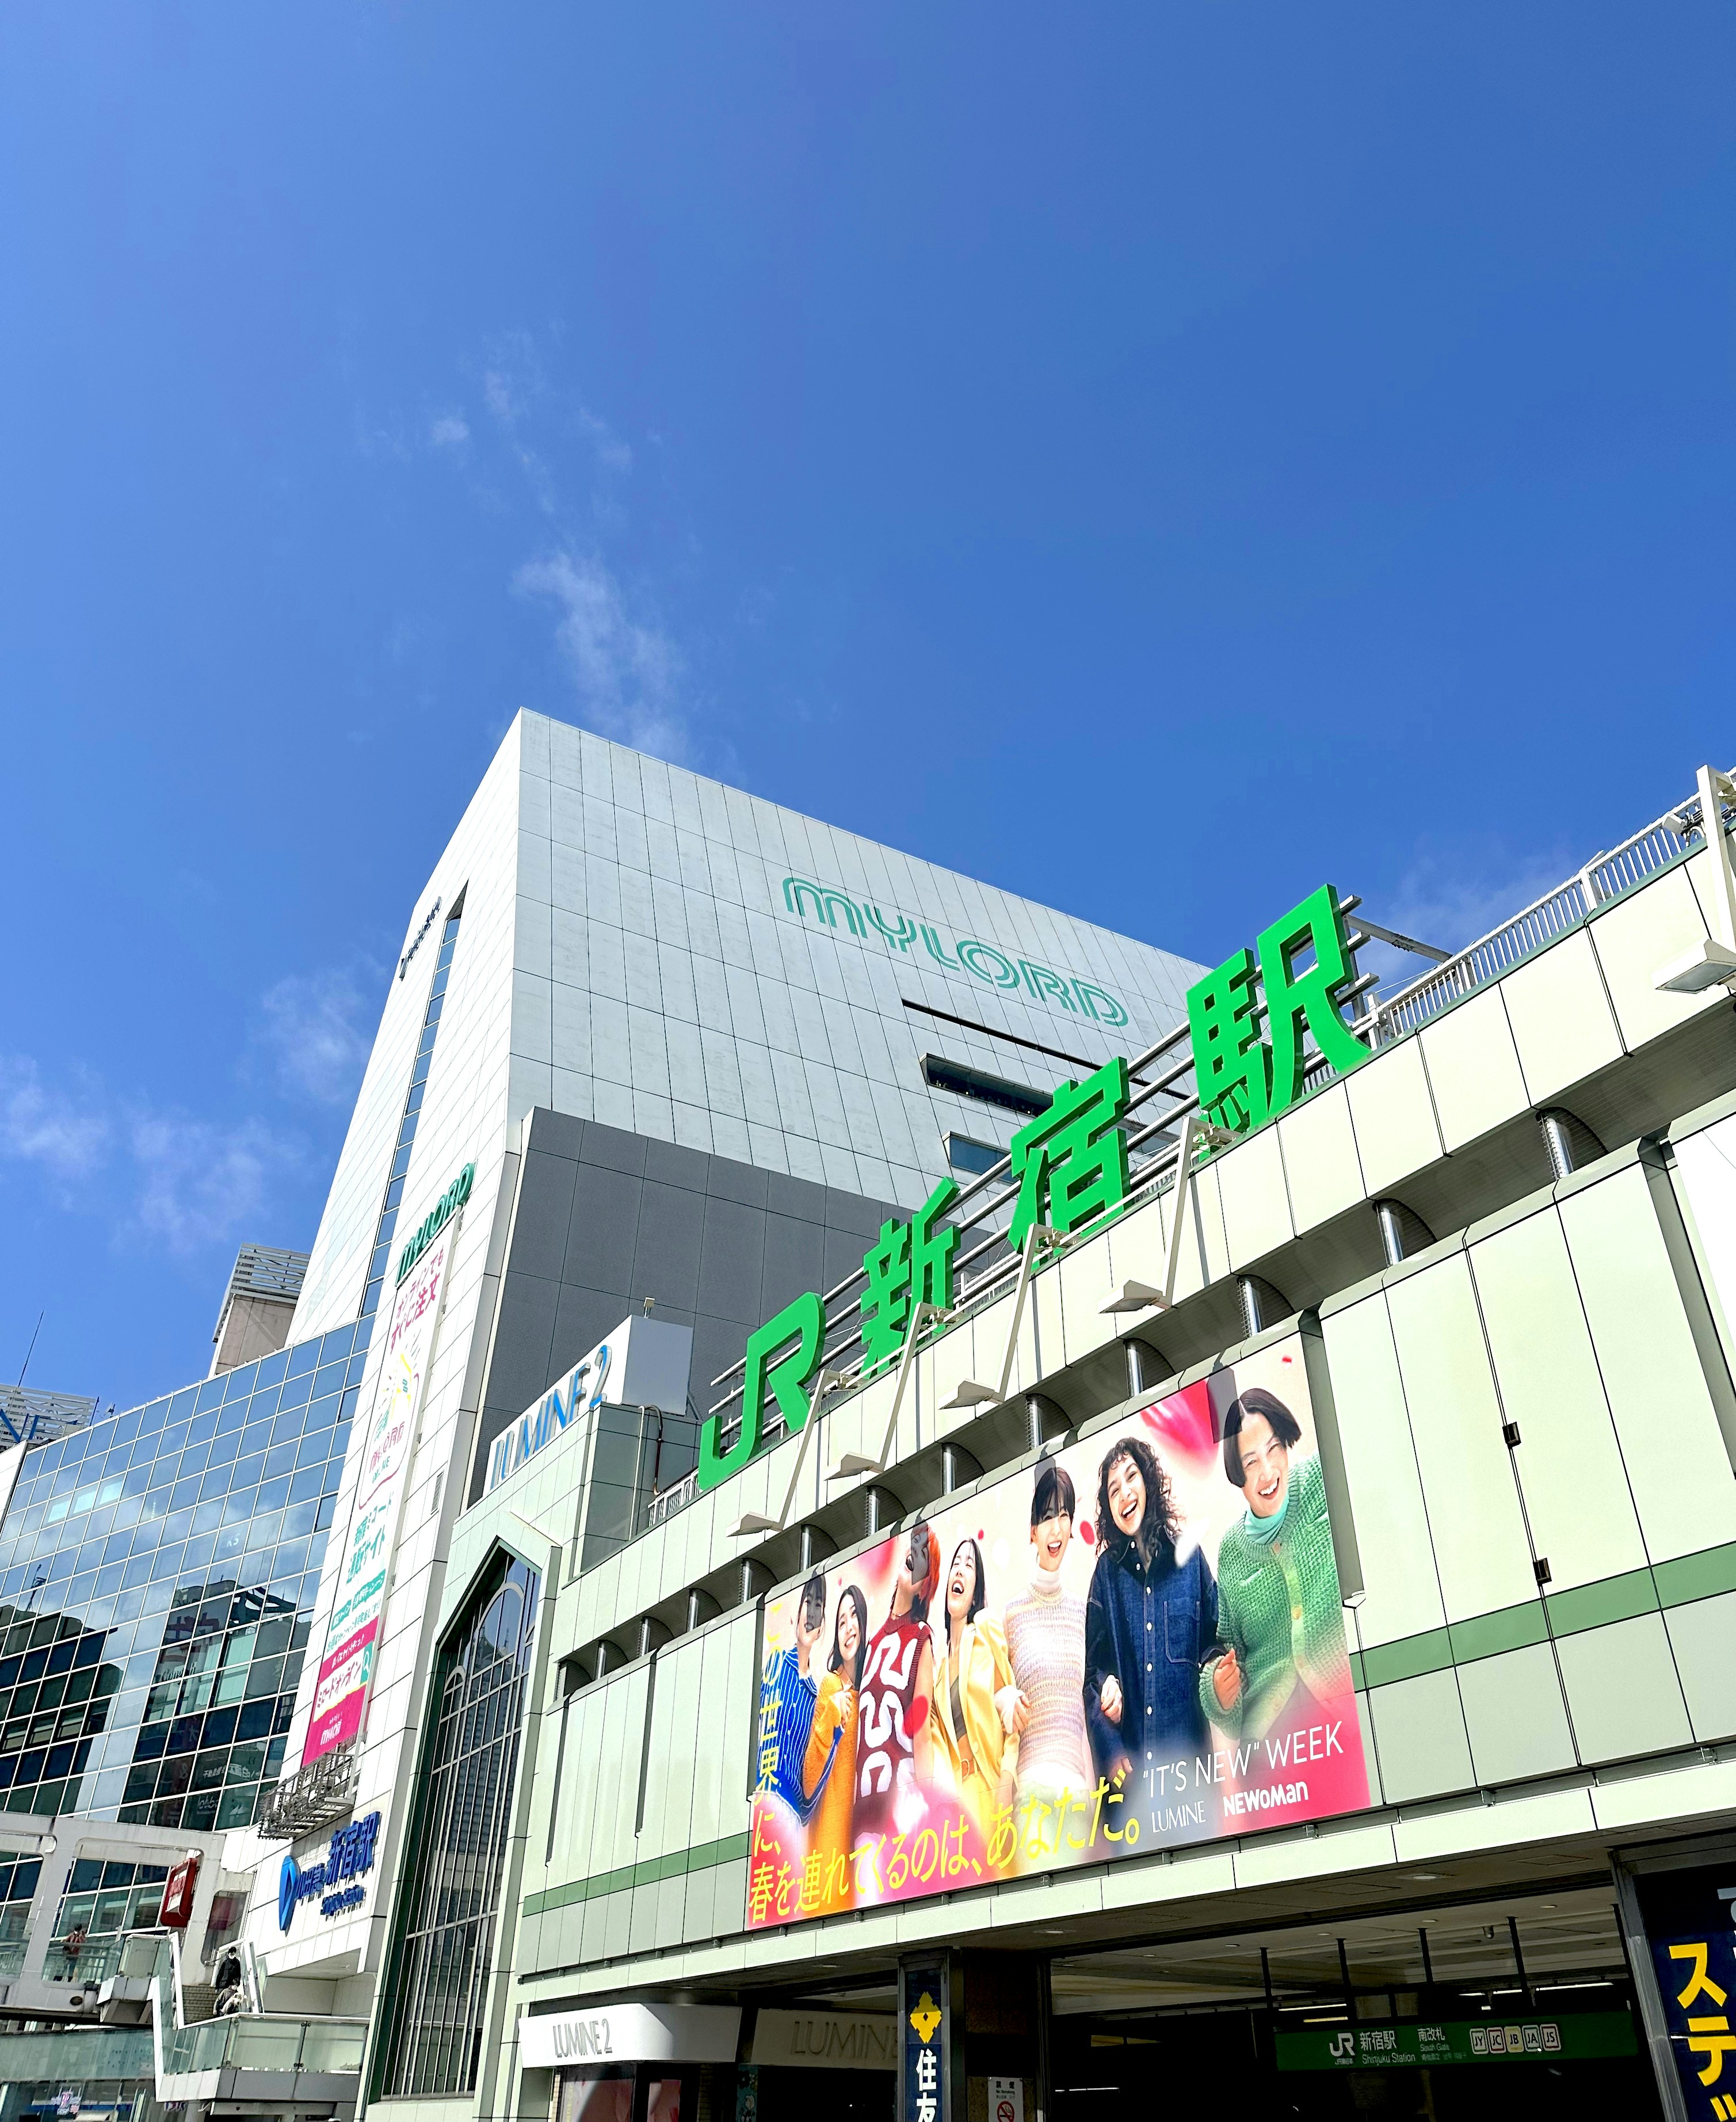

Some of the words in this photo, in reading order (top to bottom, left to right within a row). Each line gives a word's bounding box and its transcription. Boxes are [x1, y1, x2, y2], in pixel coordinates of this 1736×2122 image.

[782, 877, 1128, 1027] MYLORD
[395, 1162, 476, 1287] MYLORD
[1265, 1721, 1344, 1769] WEEK
[1223, 1781, 1308, 1817] NEWoMan
[1151, 1800, 1206, 1833] LUMINE
[749, 1769, 1140, 1923] 春を連れてくるのは、あなただ。
[1329, 2033, 1355, 2057] JR
[1359, 2030, 1397, 2051] 新宿駅
[1417, 2026, 1445, 2042] 南改札
[1475, 2036, 1483, 2047] JY
[1492, 2035, 1501, 2045] JC
[1510, 2034, 1519, 2044] JB
[1527, 2033, 1537, 2044] JA
[1546, 2032, 1555, 2043] JS
[1362, 2054, 1391, 2066] Shinjuku
[1392, 2052, 1415, 2063] Station
